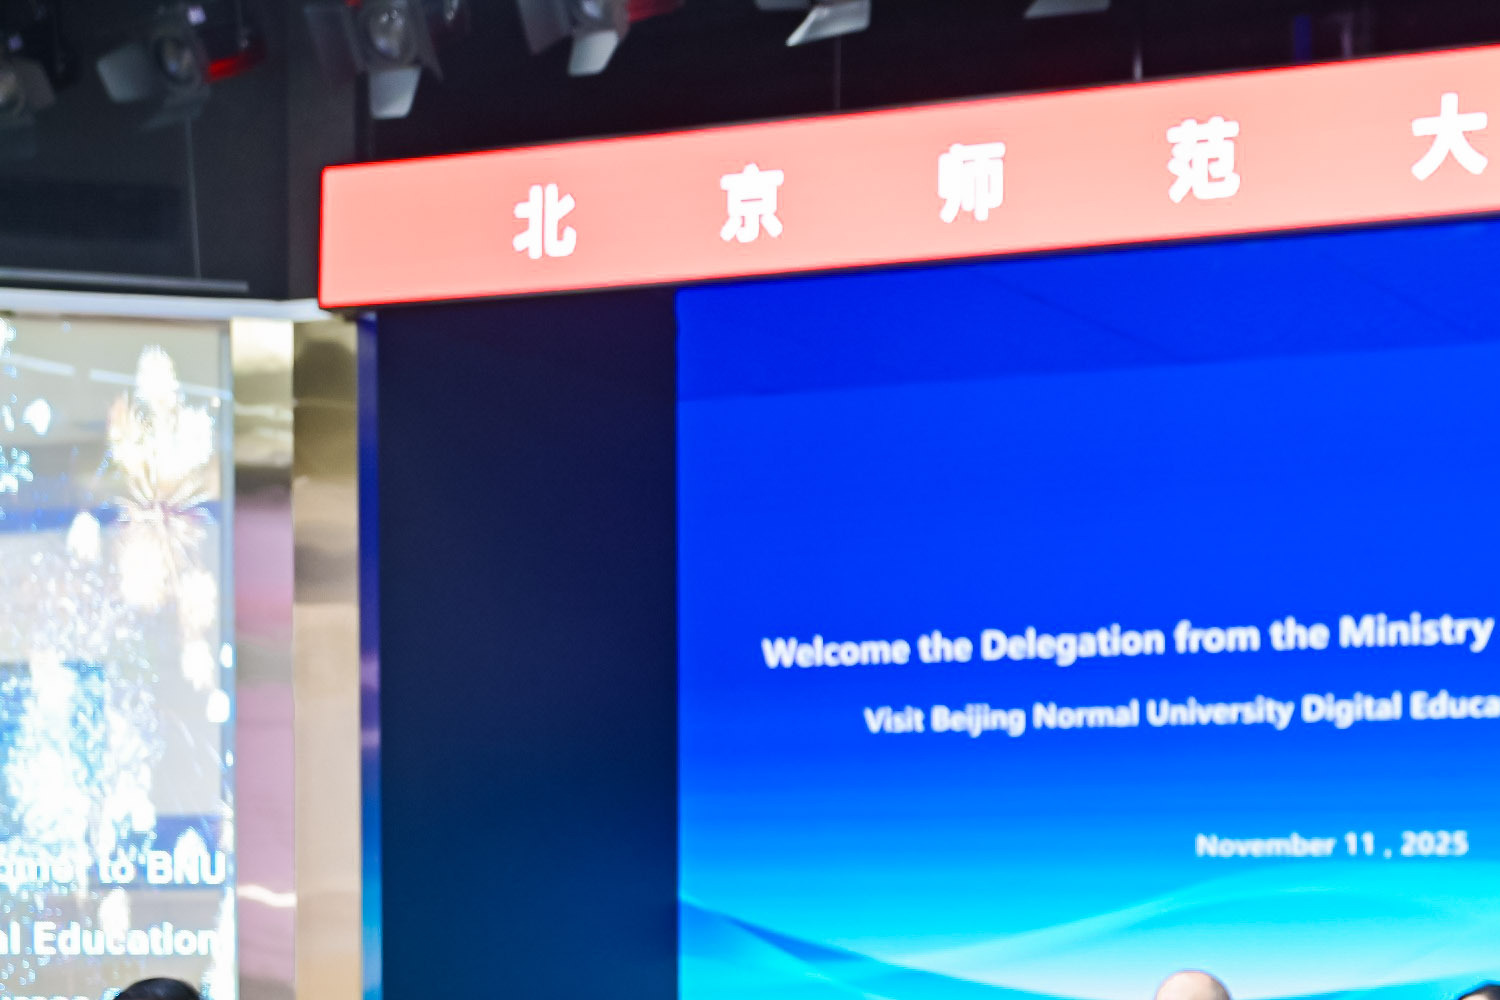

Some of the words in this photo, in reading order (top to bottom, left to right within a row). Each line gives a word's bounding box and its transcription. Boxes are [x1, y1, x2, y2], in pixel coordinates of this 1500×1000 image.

[761, 633, 911, 669] Welcome
[917, 630, 974, 664] the
[980, 623, 1166, 668] Delegation
[1173, 619, 1261, 655] from
[1269, 616, 1331, 651] the
[1339, 608, 1496, 653] Ministry
[863, 706, 925, 735] Visit
[930, 704, 1027, 738] Beijing
[1032, 699, 1140, 730] Normal
[1146, 695, 1296, 731] University
[1301, 692, 1402, 729] Digital
[1195, 833, 1336, 857] November
[1400, 831, 1469, 857] 2025
[100, 848, 136, 884] to
[147, 850, 226, 885] BNU
[33, 920, 218, 956] Education
